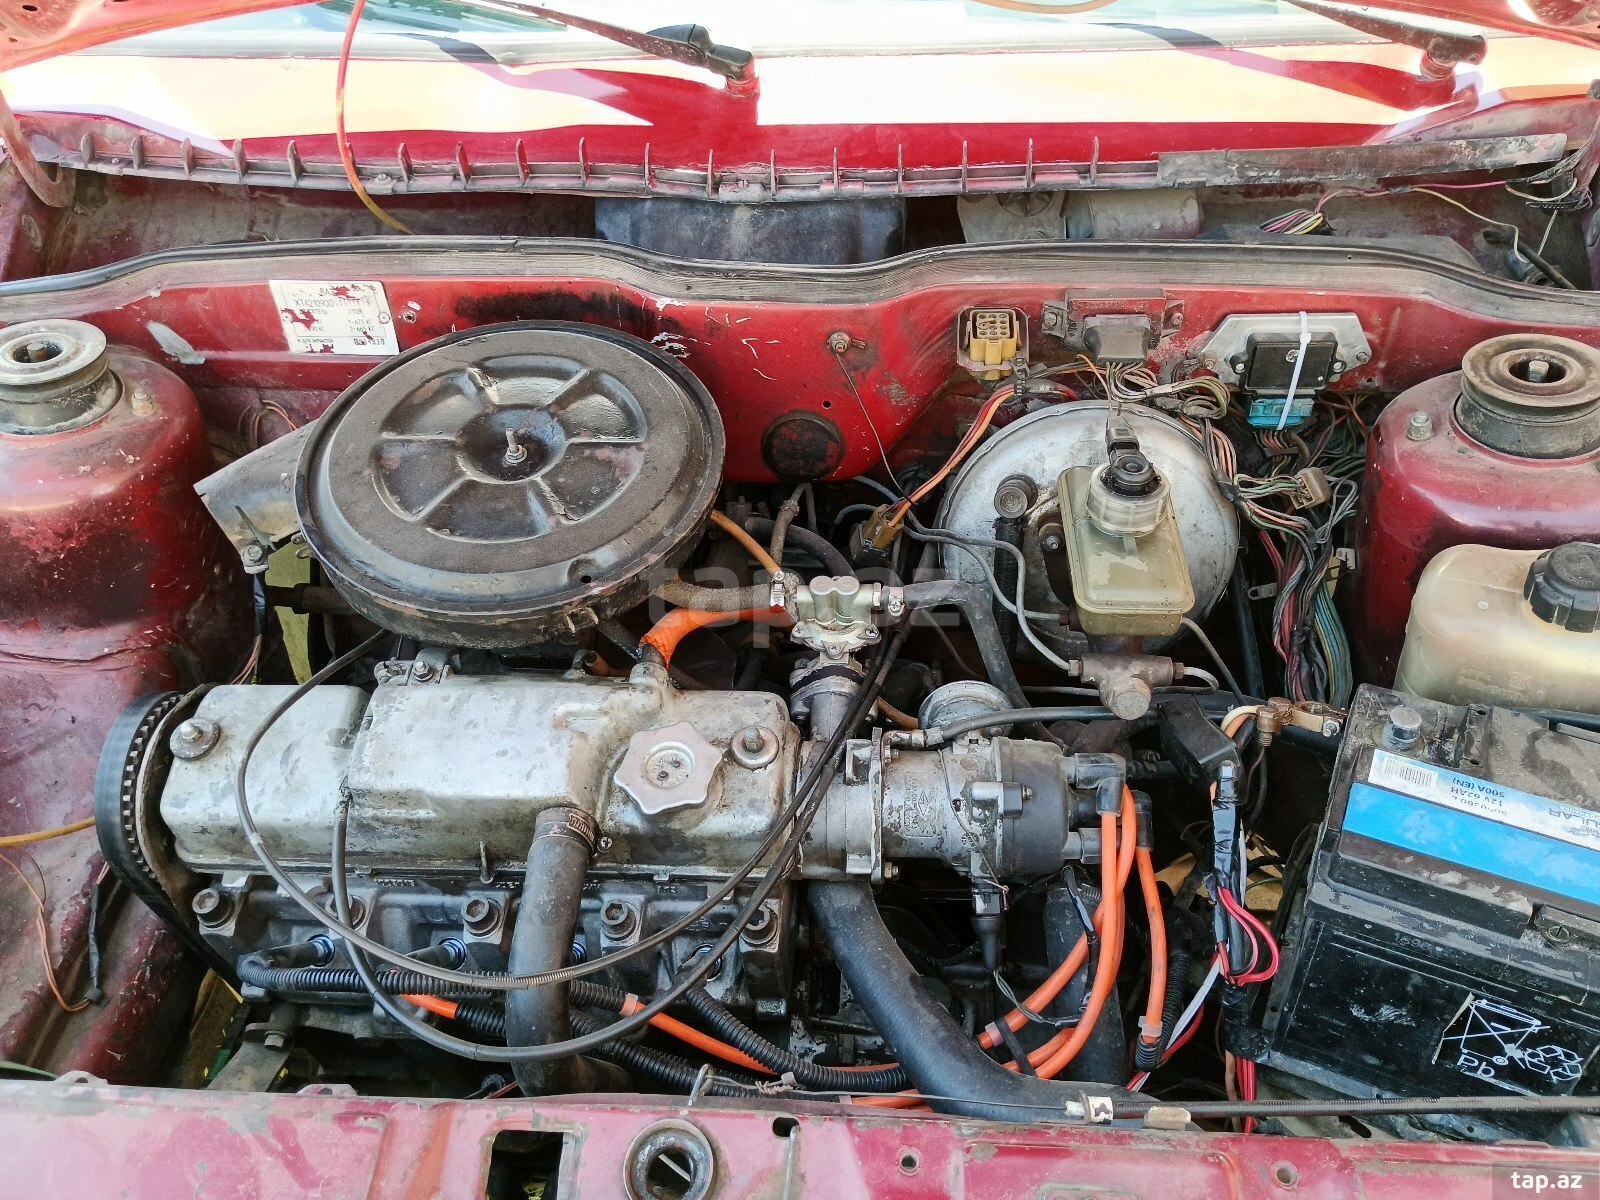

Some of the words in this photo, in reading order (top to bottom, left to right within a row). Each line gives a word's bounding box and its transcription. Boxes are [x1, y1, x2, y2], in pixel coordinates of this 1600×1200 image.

[1452, 777, 1475, 790] (EN)
[1477, 785, 1505, 798] 500A
[1456, 1054, 1496, 1078] Pb
